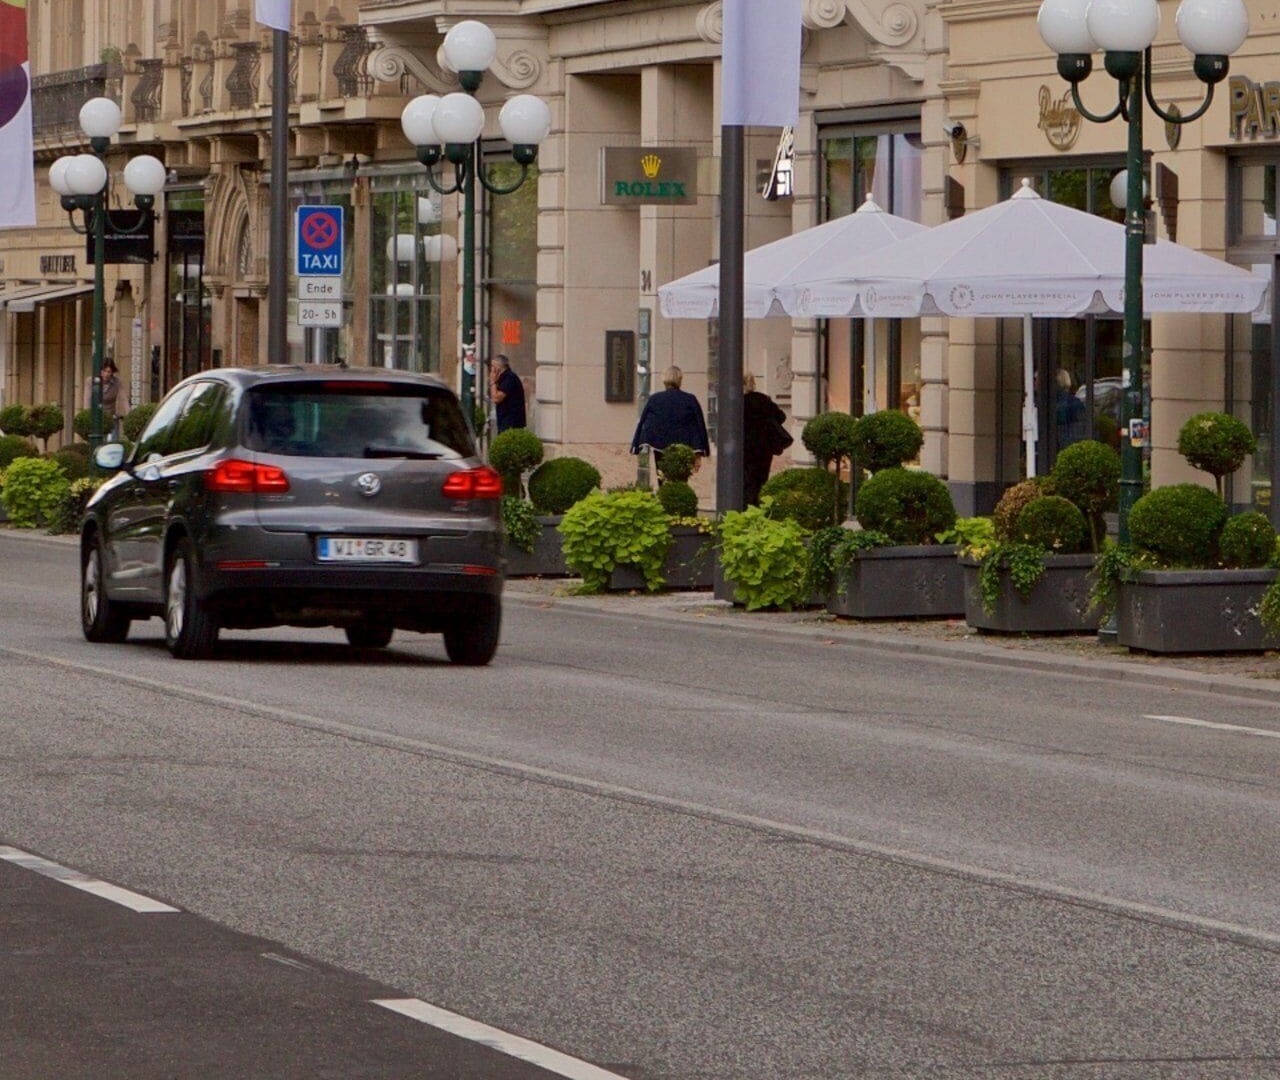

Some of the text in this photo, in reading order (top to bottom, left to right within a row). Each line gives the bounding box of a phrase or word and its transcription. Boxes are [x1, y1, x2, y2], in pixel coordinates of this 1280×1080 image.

[614, 181, 687, 198] ROLEX
[302, 253, 339, 270] TAXI
[306, 283, 334, 294] Ende
[302, 309, 319, 320] 20-
